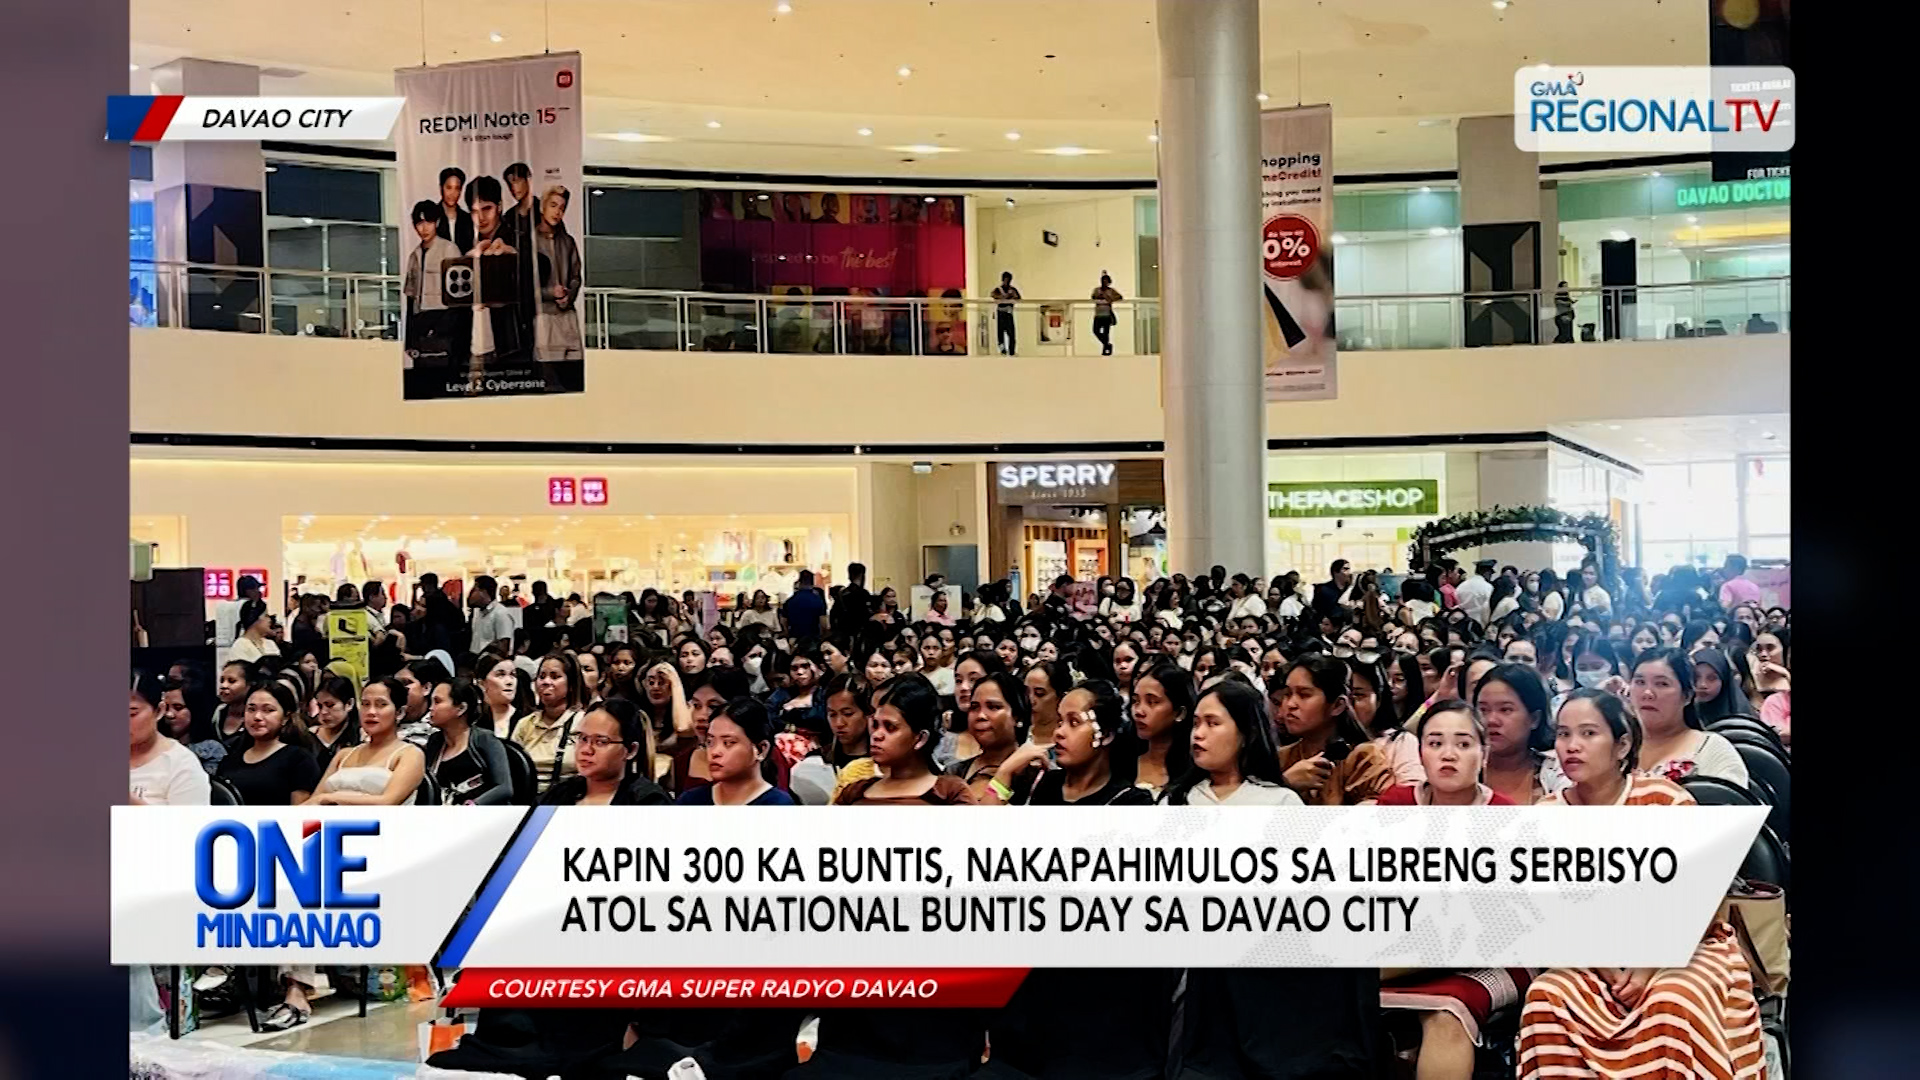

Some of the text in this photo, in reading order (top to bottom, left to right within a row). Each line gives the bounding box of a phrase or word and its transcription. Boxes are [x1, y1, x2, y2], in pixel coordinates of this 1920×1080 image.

[420, 107, 557, 134] REDMI Note 15
[1677, 185, 1729, 206] DAVAO
[1262, 237, 1310, 260] 0%
[486, 379, 546, 391] Cyberzone
[1000, 463, 1116, 488] SPERRY
